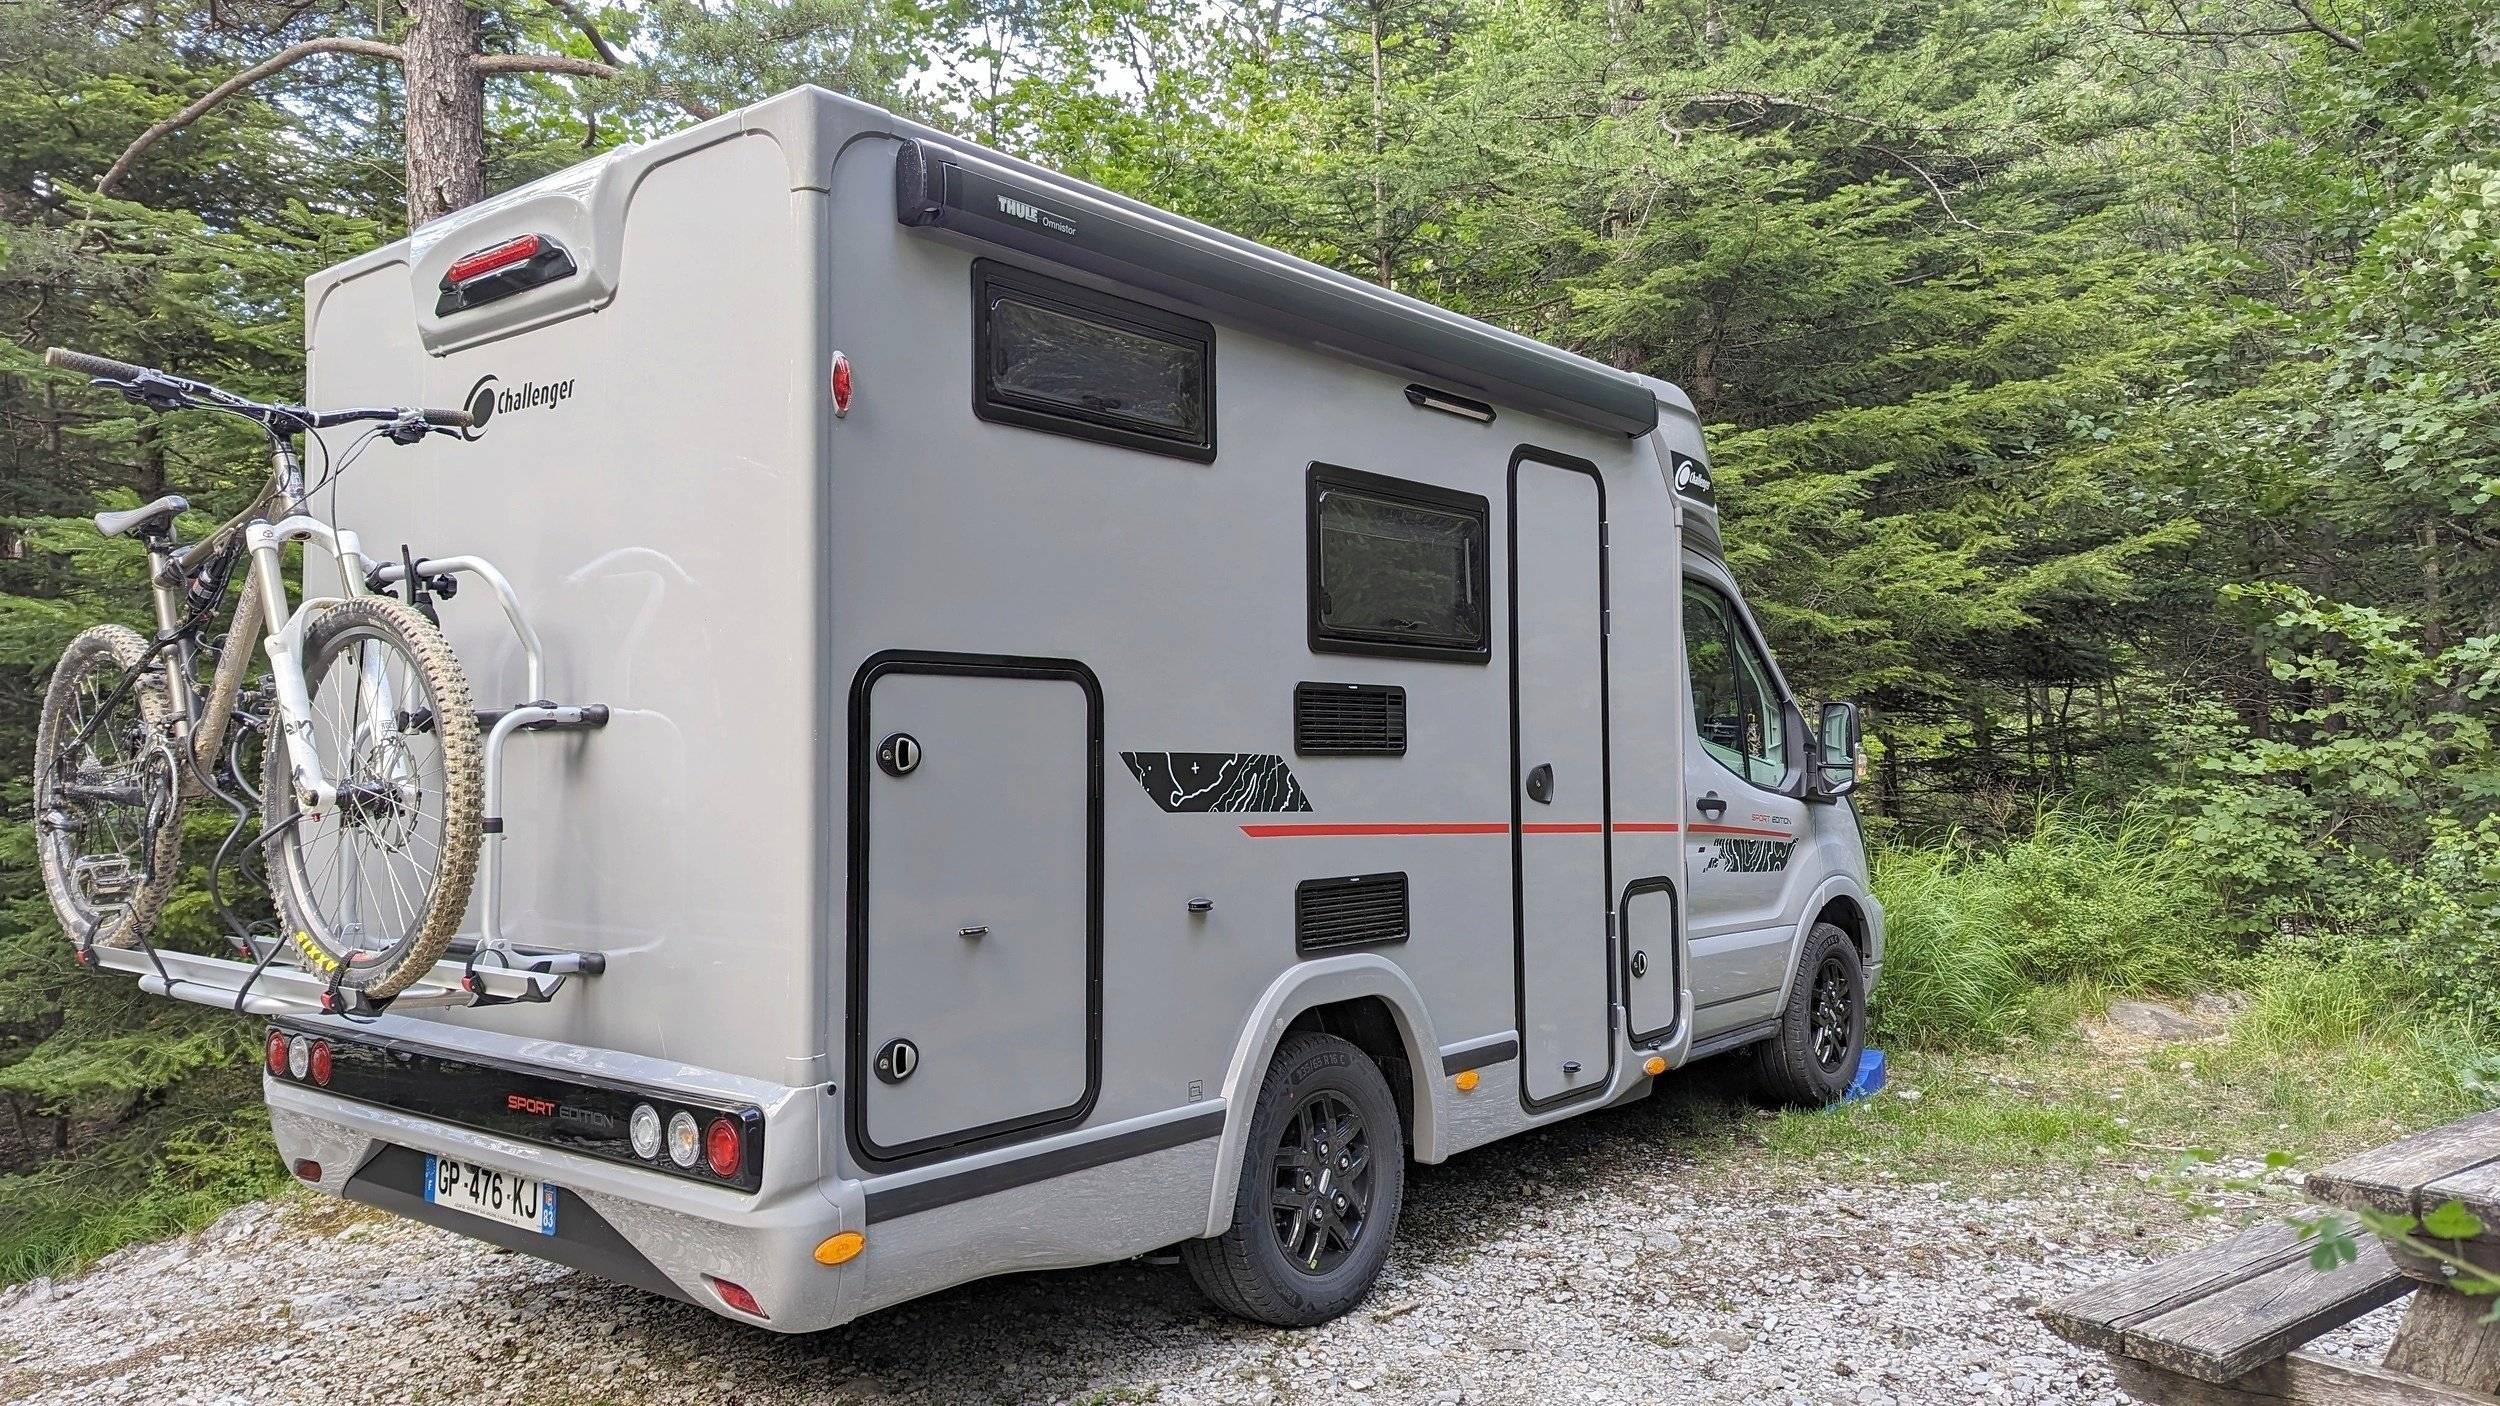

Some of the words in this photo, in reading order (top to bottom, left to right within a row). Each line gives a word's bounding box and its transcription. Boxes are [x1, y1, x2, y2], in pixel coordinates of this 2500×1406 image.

[997, 194, 1038, 223] THULE
[1042, 216, 1076, 236] Omnistor
[498, 379, 575, 414] Challenger
[1752, 813, 1770, 824] SPORT
[1772, 815, 1792, 825] EDITION
[295, 931, 339, 972] AXXIS
[508, 1095, 555, 1116] SPORT
[560, 1106, 614, 1128] EDITION
[543, 1209, 554, 1228] 83
